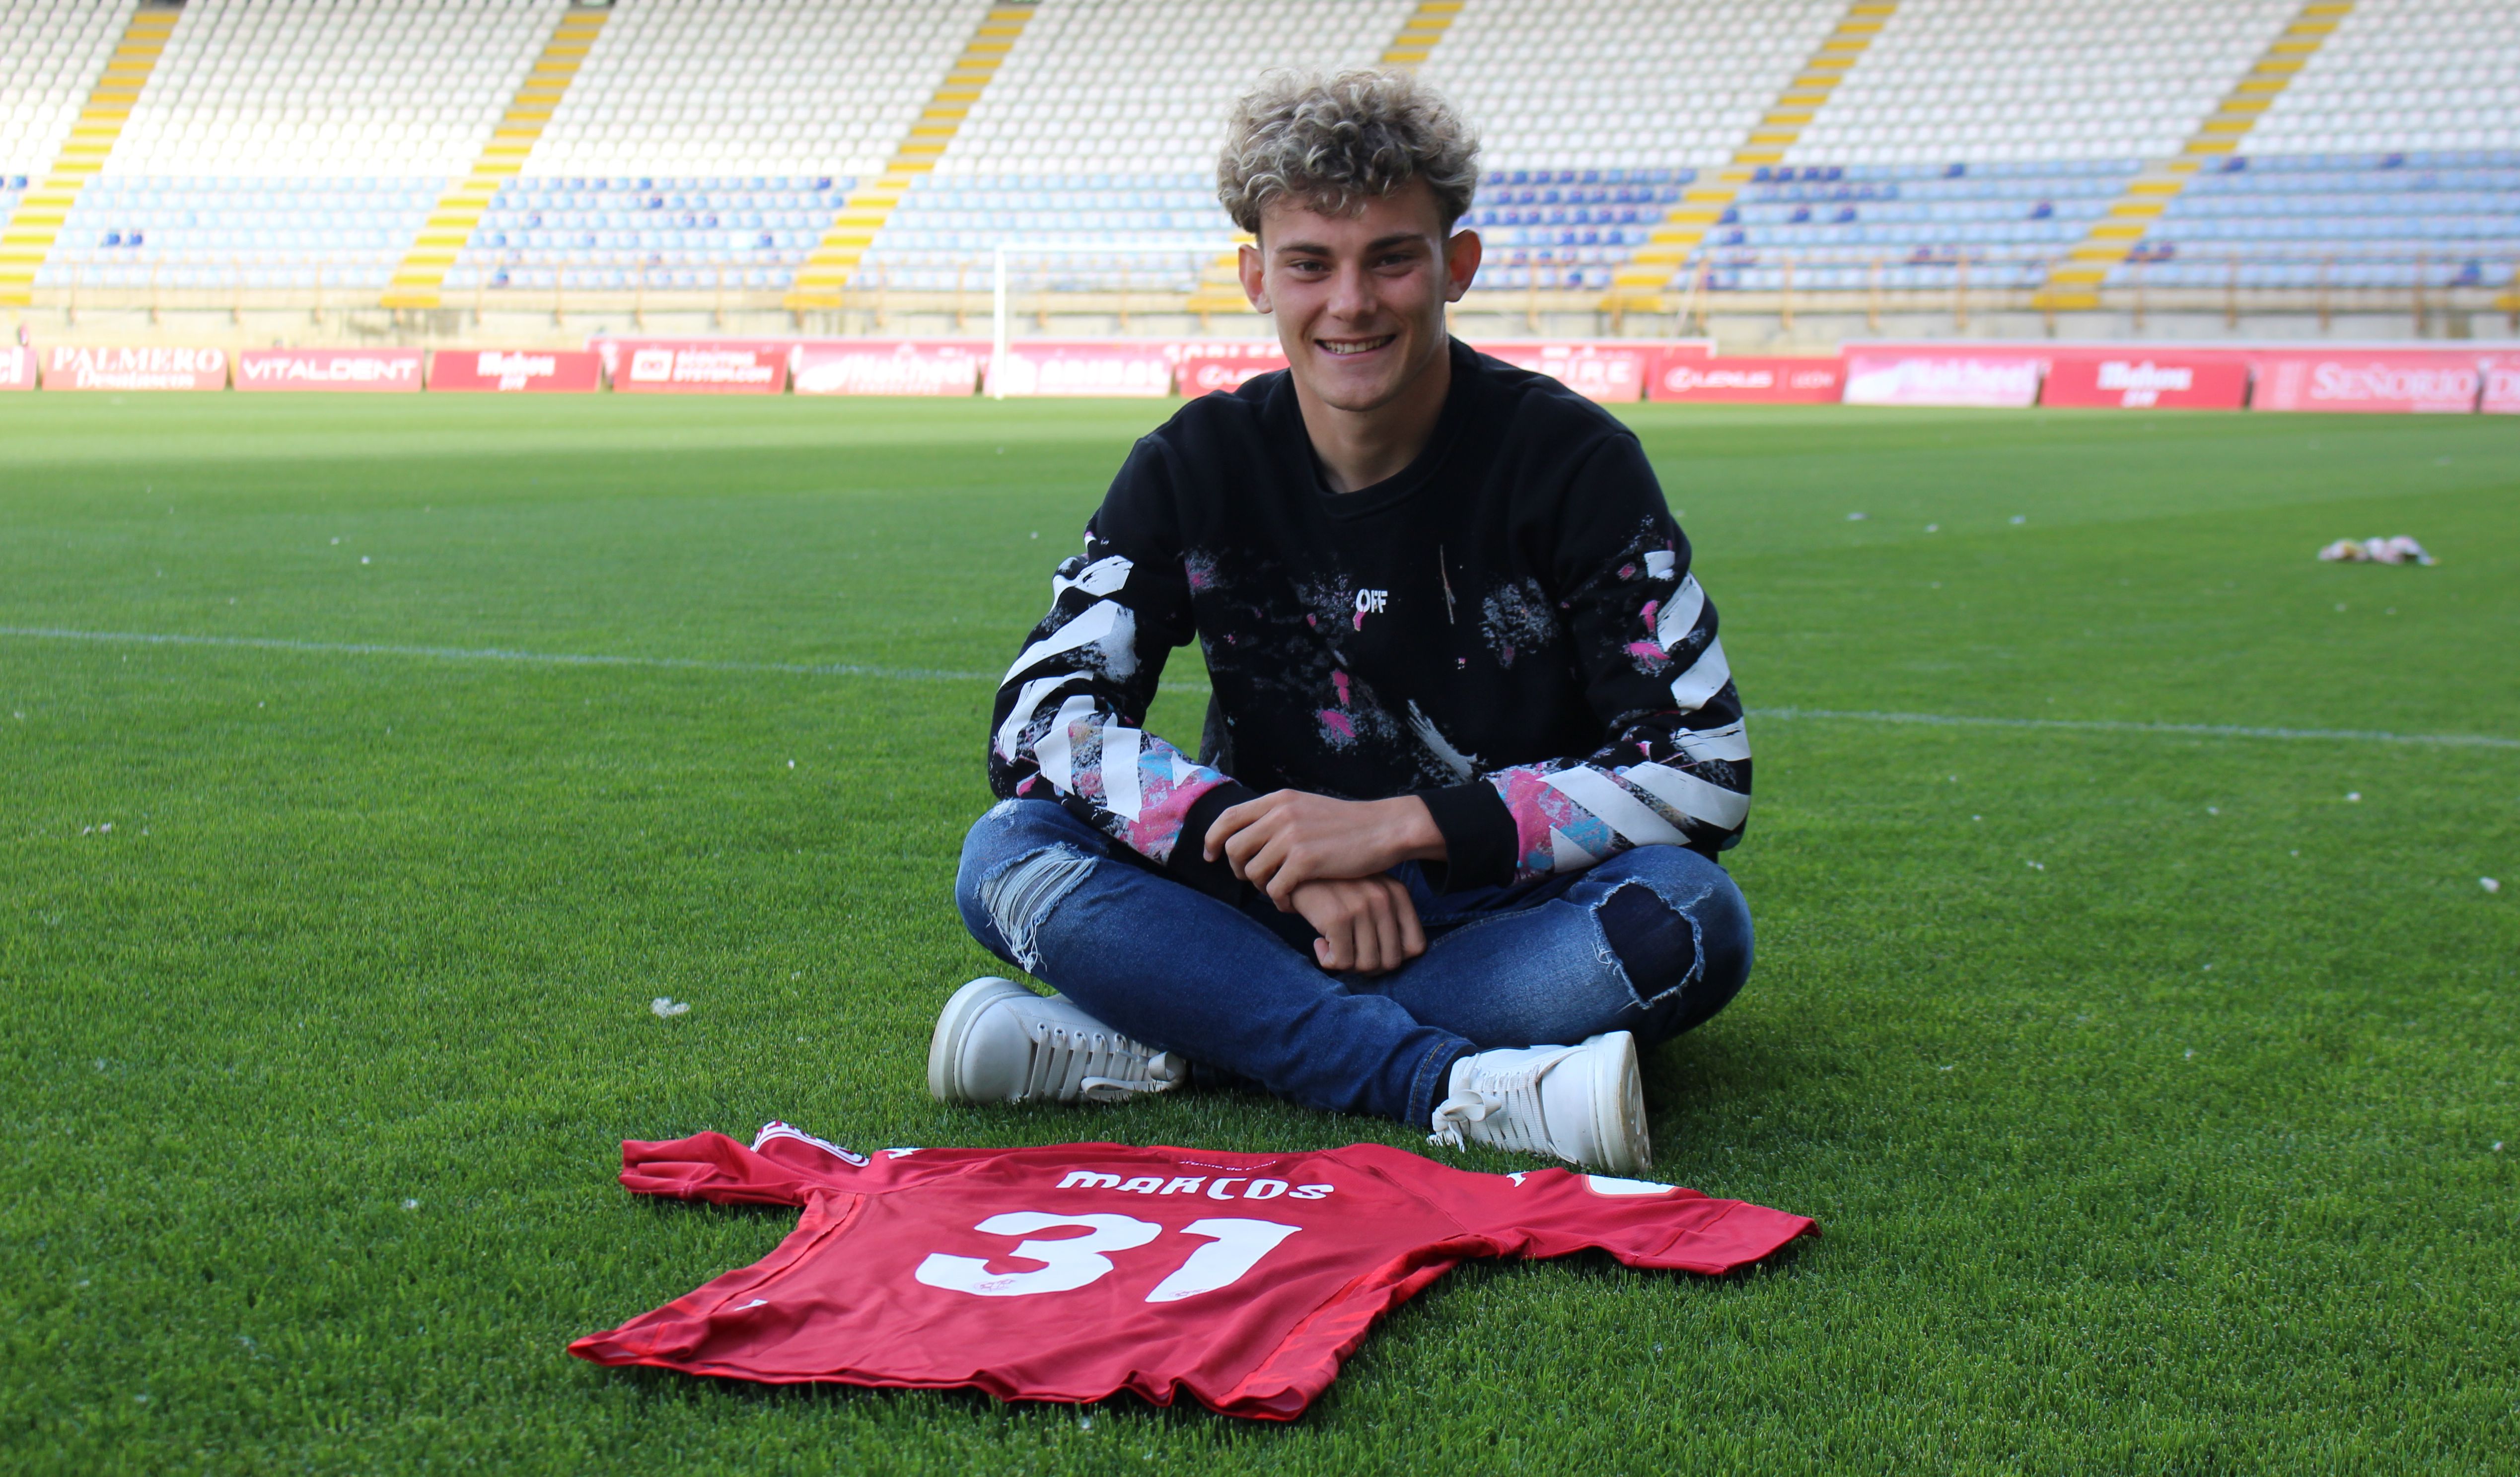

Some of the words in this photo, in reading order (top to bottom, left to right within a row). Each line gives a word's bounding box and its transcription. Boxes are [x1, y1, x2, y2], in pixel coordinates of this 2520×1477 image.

[52, 347, 224, 373] PALMERO
[242, 357, 419, 380] VITALDENT
[1356, 588, 1388, 614] OFF
[1055, 1170, 1335, 1200] MARCOS
[914, 1211, 1303, 1303] 31
